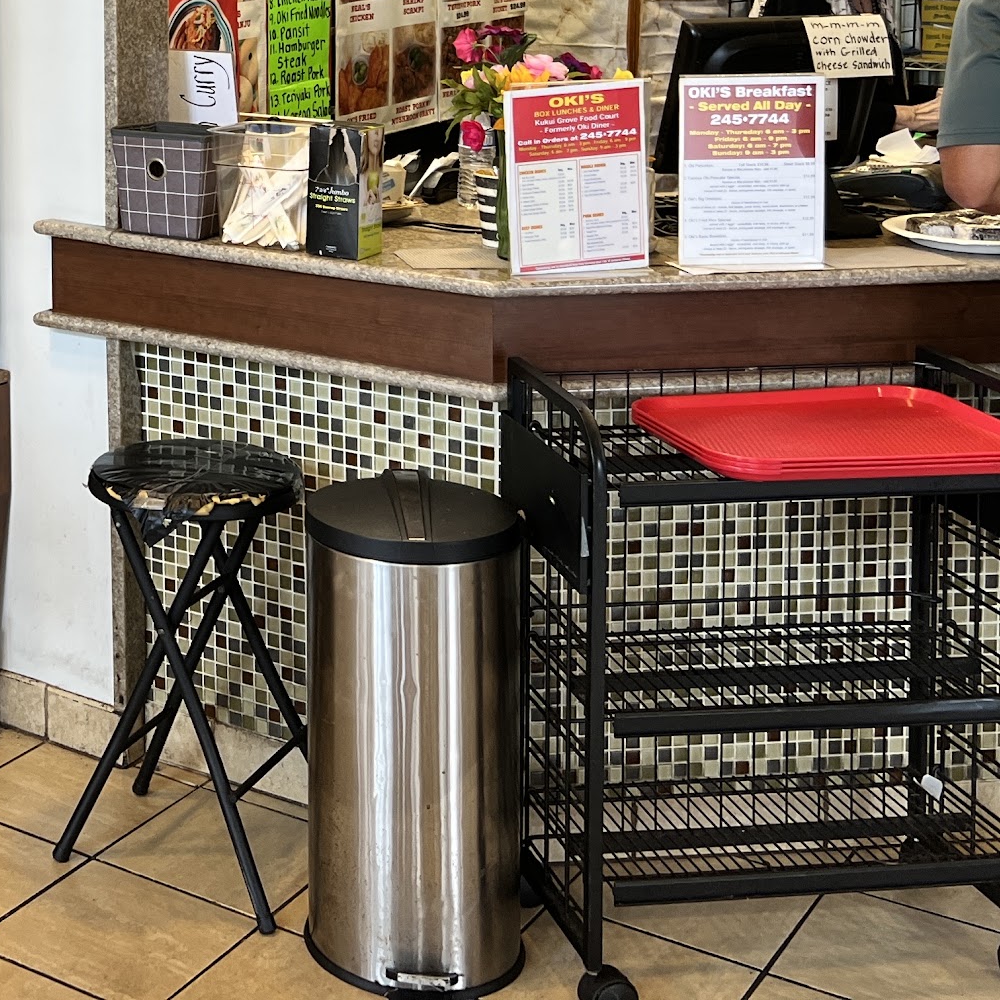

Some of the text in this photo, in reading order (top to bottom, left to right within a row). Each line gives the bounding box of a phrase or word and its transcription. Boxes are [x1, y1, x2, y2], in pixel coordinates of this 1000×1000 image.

[280, 23, 310, 41] Pansit
[279, 39, 325, 57] Hamburger
[816, 47, 878, 56] with Grilled
[278, 53, 307, 69] Steak
[179, 55, 230, 107] Curry
[281, 64, 325, 85] Roast Pork
[282, 88, 311, 109] Teriyaki
[688, 85, 813, 99] OKI'S Breakfast
[549, 93, 605, 108] OKI'S
[698, 100, 802, 112] Served All Day
[534, 110, 550, 118] BOX
[552, 107, 588, 116] LUNCHES
[596, 104, 619, 112] DINER
[535, 118, 555, 126] Kukui
[557, 116, 578, 124] Grove
[599, 112, 619, 120] Court
[544, 124, 576, 133] Formerly
[542, 136, 569, 144] Orders
[309, 192, 356, 204] Straight Straws
